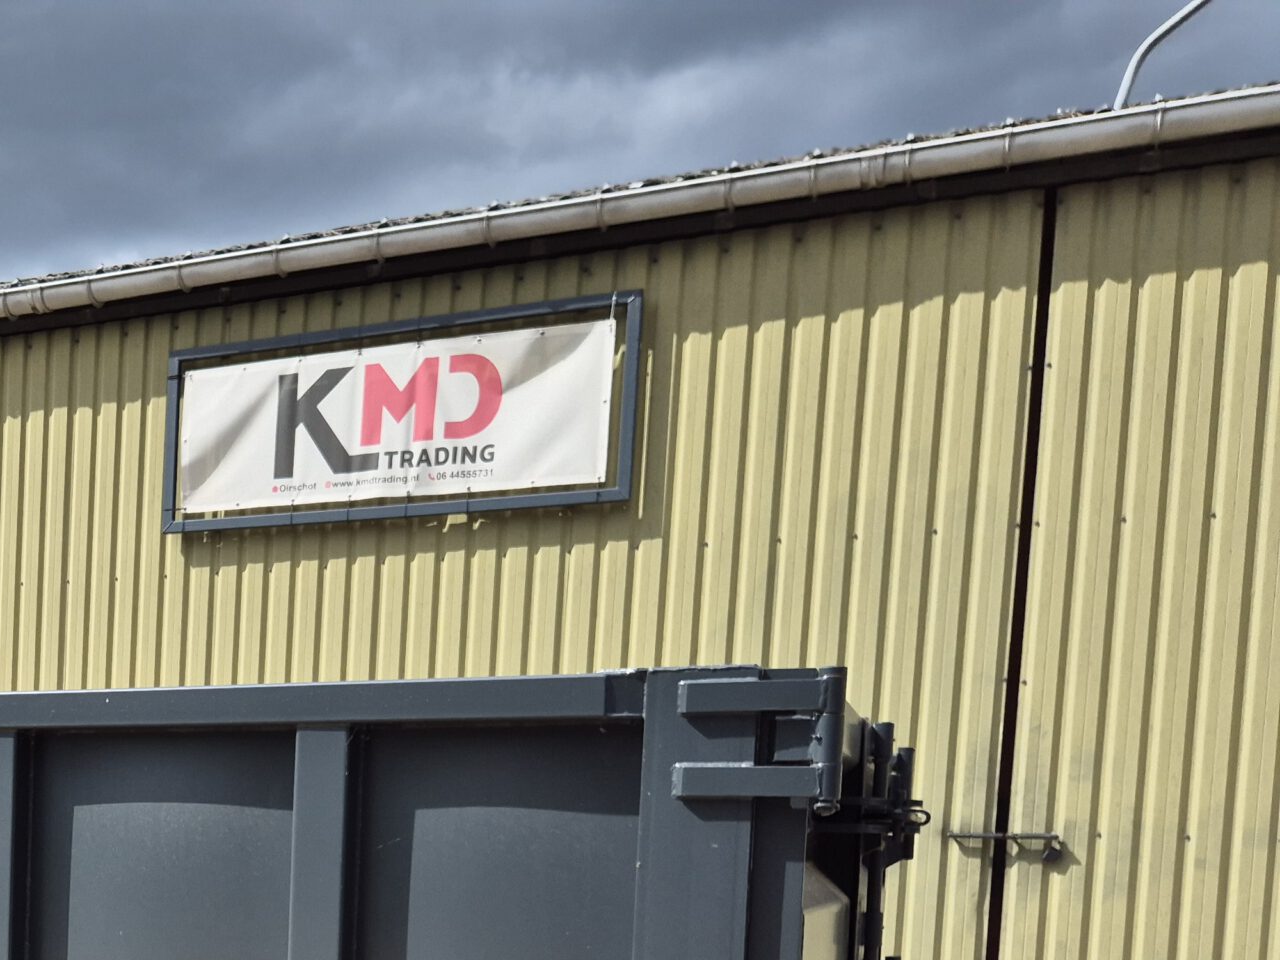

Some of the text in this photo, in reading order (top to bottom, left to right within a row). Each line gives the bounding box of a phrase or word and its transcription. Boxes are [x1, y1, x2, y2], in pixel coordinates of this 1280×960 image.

[274, 354, 503, 480] KMD
[384, 444, 496, 470] TRADING
[332, 474, 420, 489] wwwkmdtradingnl
[436, 471, 448, 480] 06
